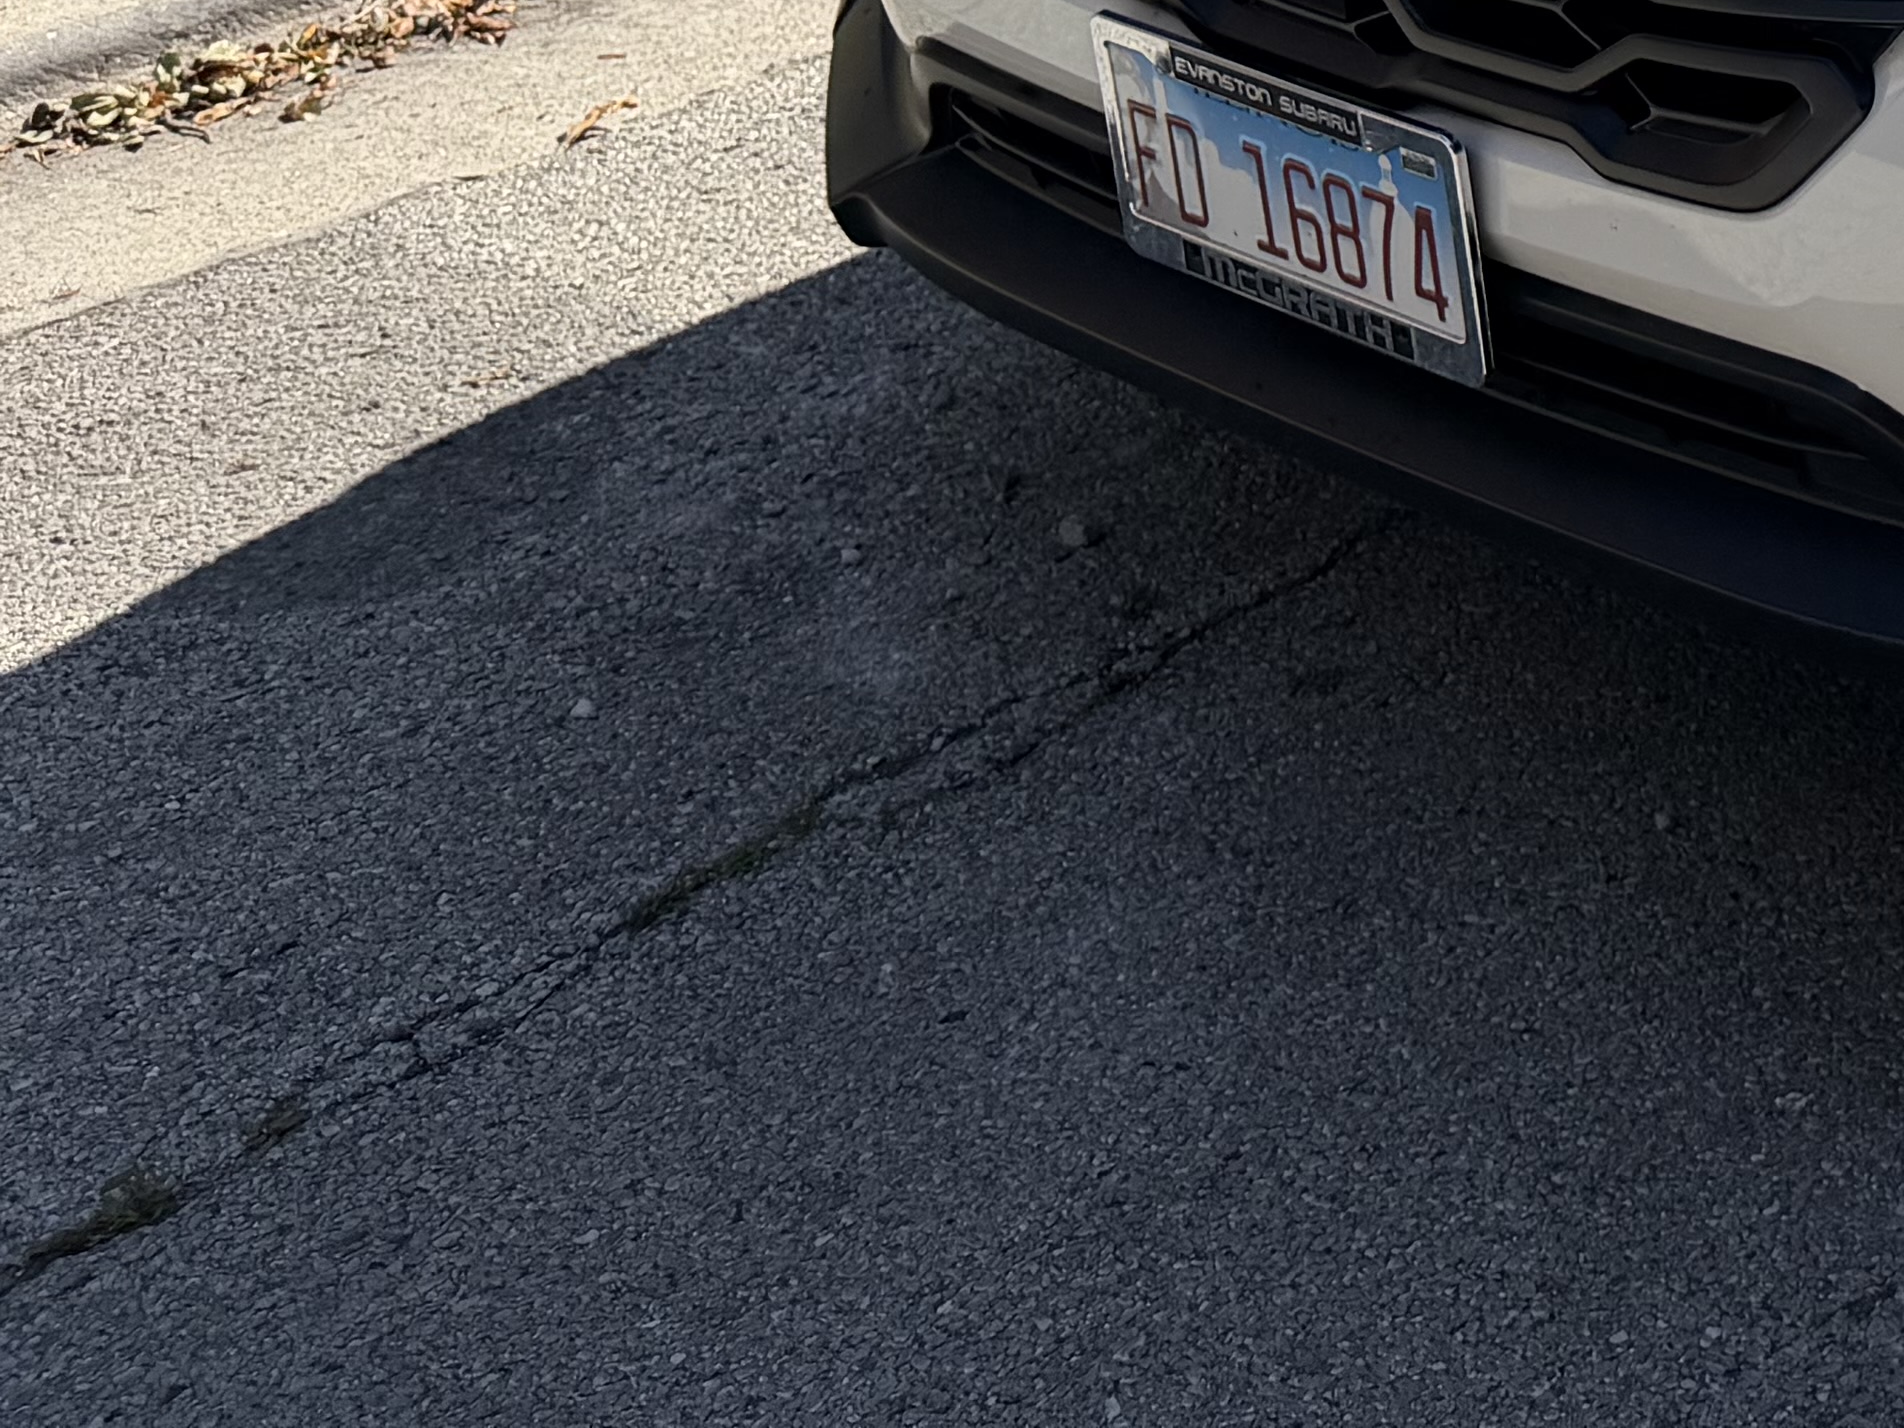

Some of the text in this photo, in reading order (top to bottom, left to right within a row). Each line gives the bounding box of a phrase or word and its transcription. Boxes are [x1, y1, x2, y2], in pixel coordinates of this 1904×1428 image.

[1175, 55, 1272, 106] EVANSTON
[1279, 96, 1367, 136] SUBARU
[1127, 98, 1209, 228] FD
[1242, 140, 1449, 323] 16874
